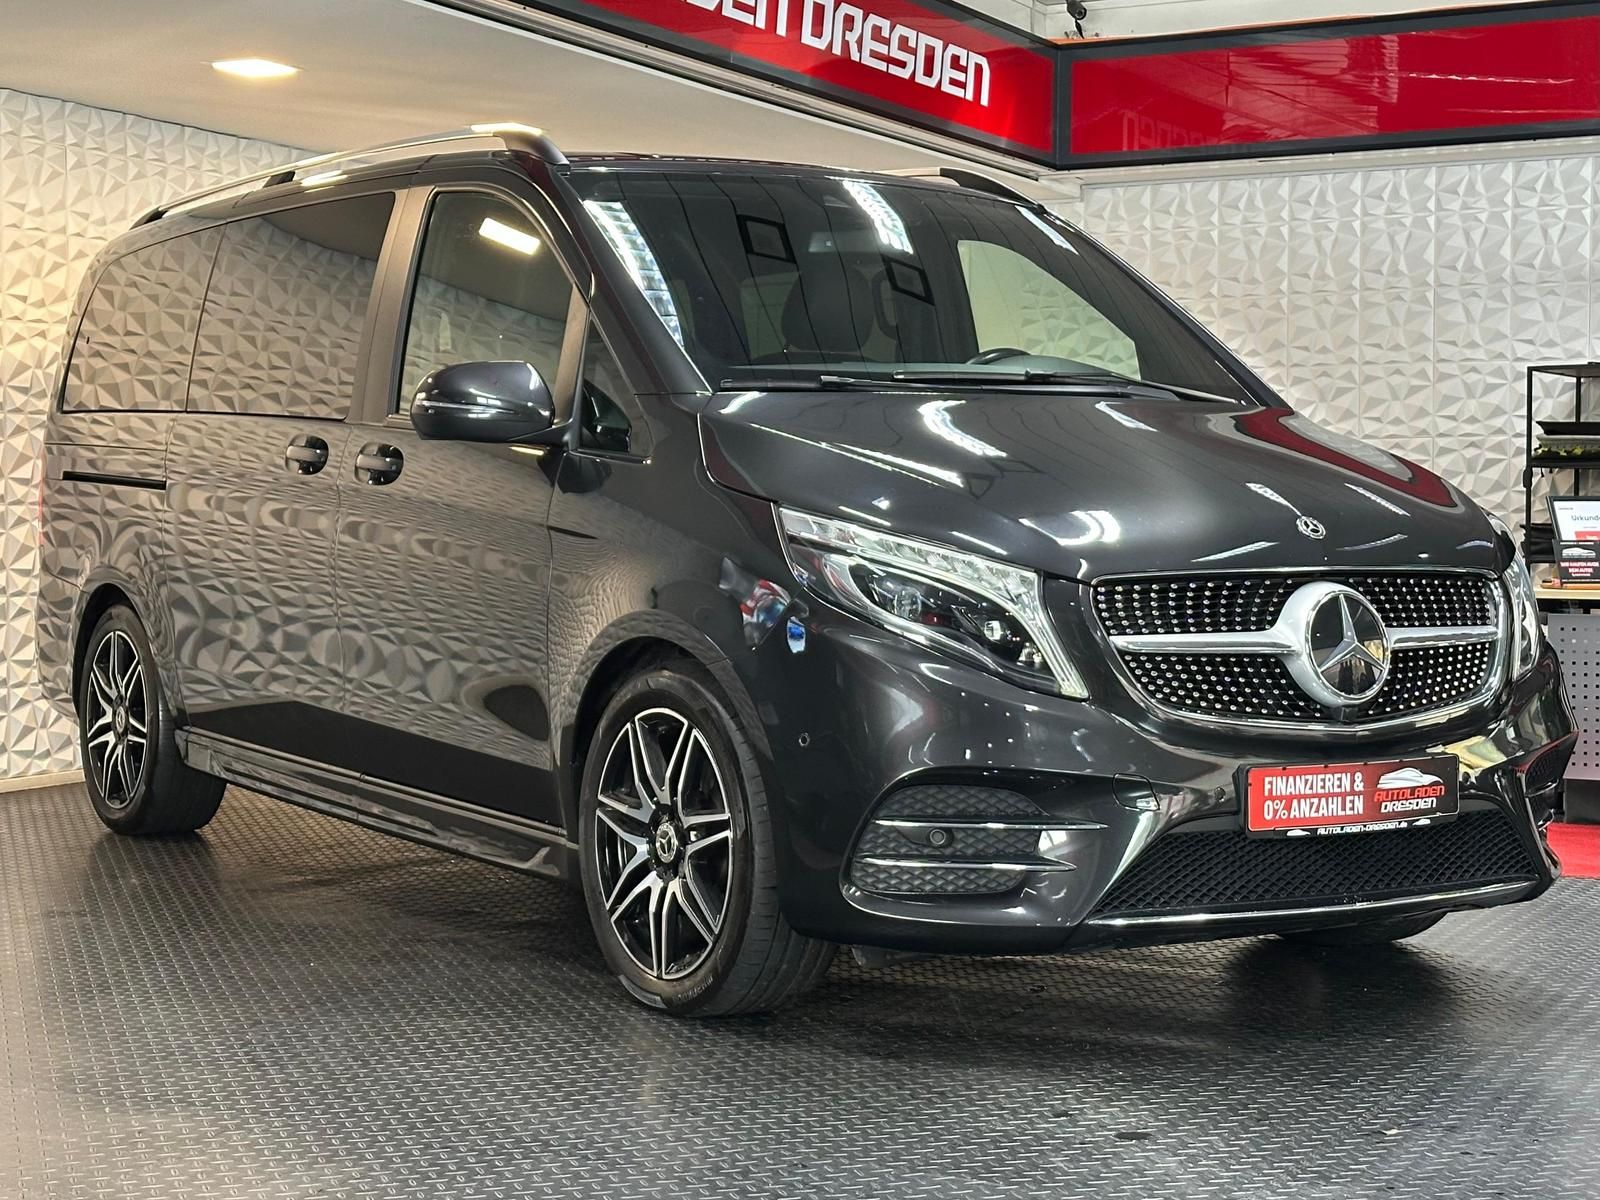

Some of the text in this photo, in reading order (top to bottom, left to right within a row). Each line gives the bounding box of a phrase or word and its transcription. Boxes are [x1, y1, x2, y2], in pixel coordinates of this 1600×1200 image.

[801, 0, 990, 107] DRESDEN
[1264, 771, 1365, 796] FINANZIEREN &
[1374, 785, 1445, 802] AUTOLADEN
[1263, 795, 1364, 820] 0% ANZAHLEN
[1380, 797, 1437, 813] DRESDEN
